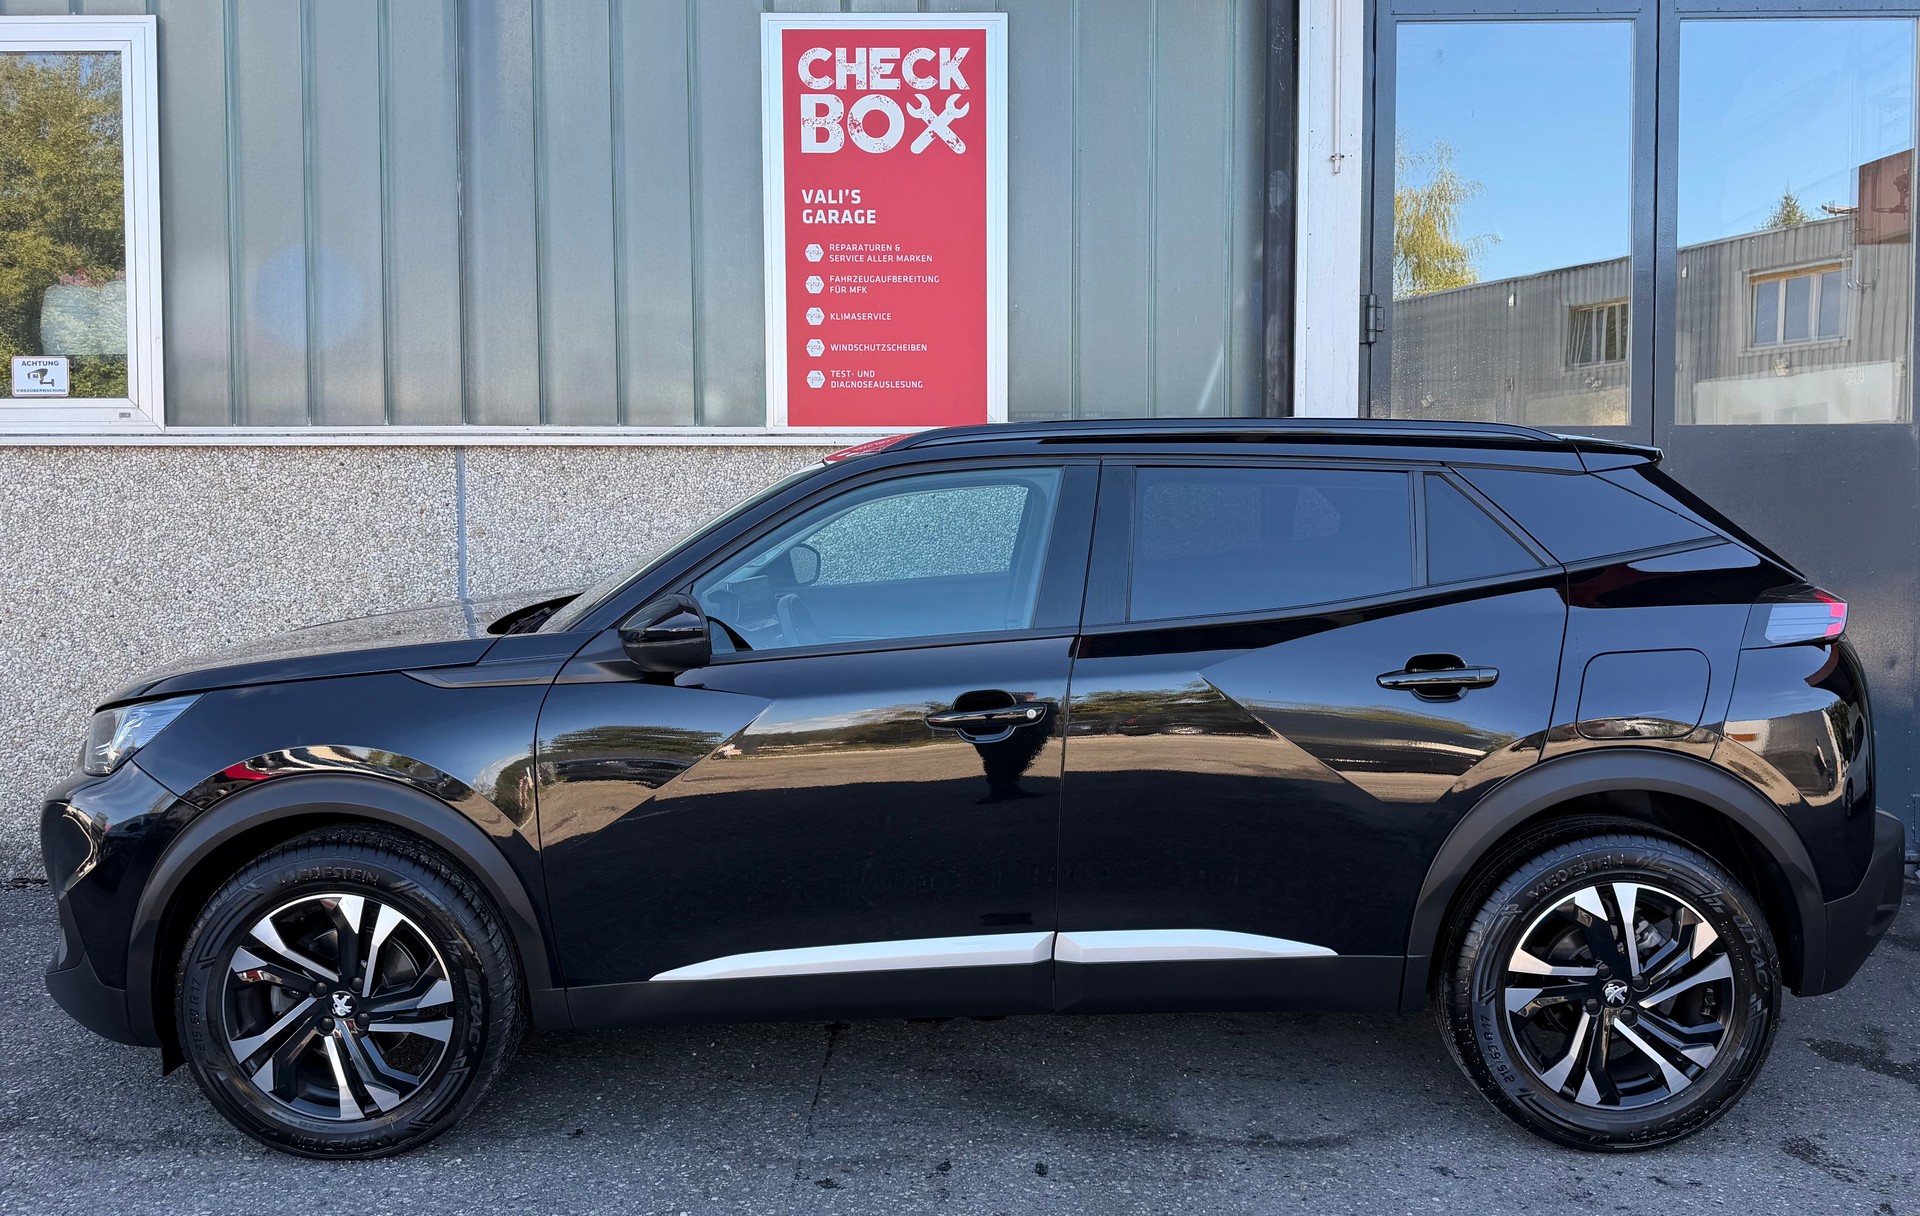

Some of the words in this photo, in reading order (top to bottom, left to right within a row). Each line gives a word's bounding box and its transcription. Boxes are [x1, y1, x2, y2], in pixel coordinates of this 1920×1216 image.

[798, 47, 970, 90] CHECK
[802, 189, 861, 204] VALI'S
[802, 209, 877, 224] GARAGE
[829, 244, 892, 252] REPARATUREN
[829, 275, 940, 283] FAHRZEUGAUFBEREITUNG
[829, 285, 847, 294] FÜR
[849, 286, 868, 294] MFK
[830, 313, 892, 321] KLIMASERVICE
[830, 343, 928, 351] WINDSCHUTZSCHEIBEN
[830, 370, 855, 378] TEST-
[857, 370, 876, 378] UND
[830, 381, 924, 389] DIAGNOSEAUSLESUNG
[1479, 1014, 1492, 1030] 17
